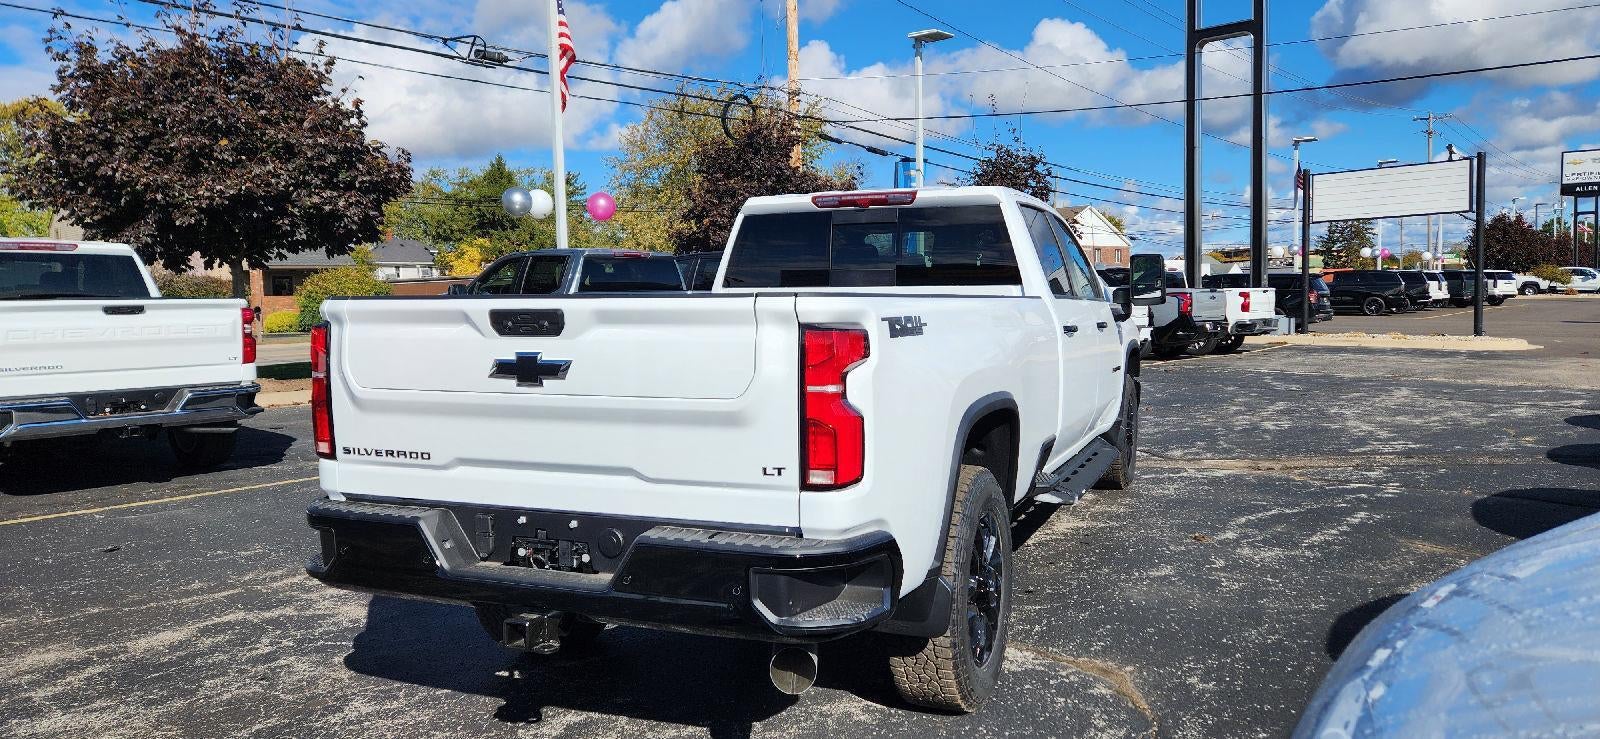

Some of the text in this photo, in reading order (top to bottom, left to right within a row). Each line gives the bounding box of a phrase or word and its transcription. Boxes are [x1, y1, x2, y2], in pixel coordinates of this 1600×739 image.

[6, 324, 228, 342] CHEVROLET
[342, 446, 431, 460] SILVERADO
[762, 466, 786, 477] LT
